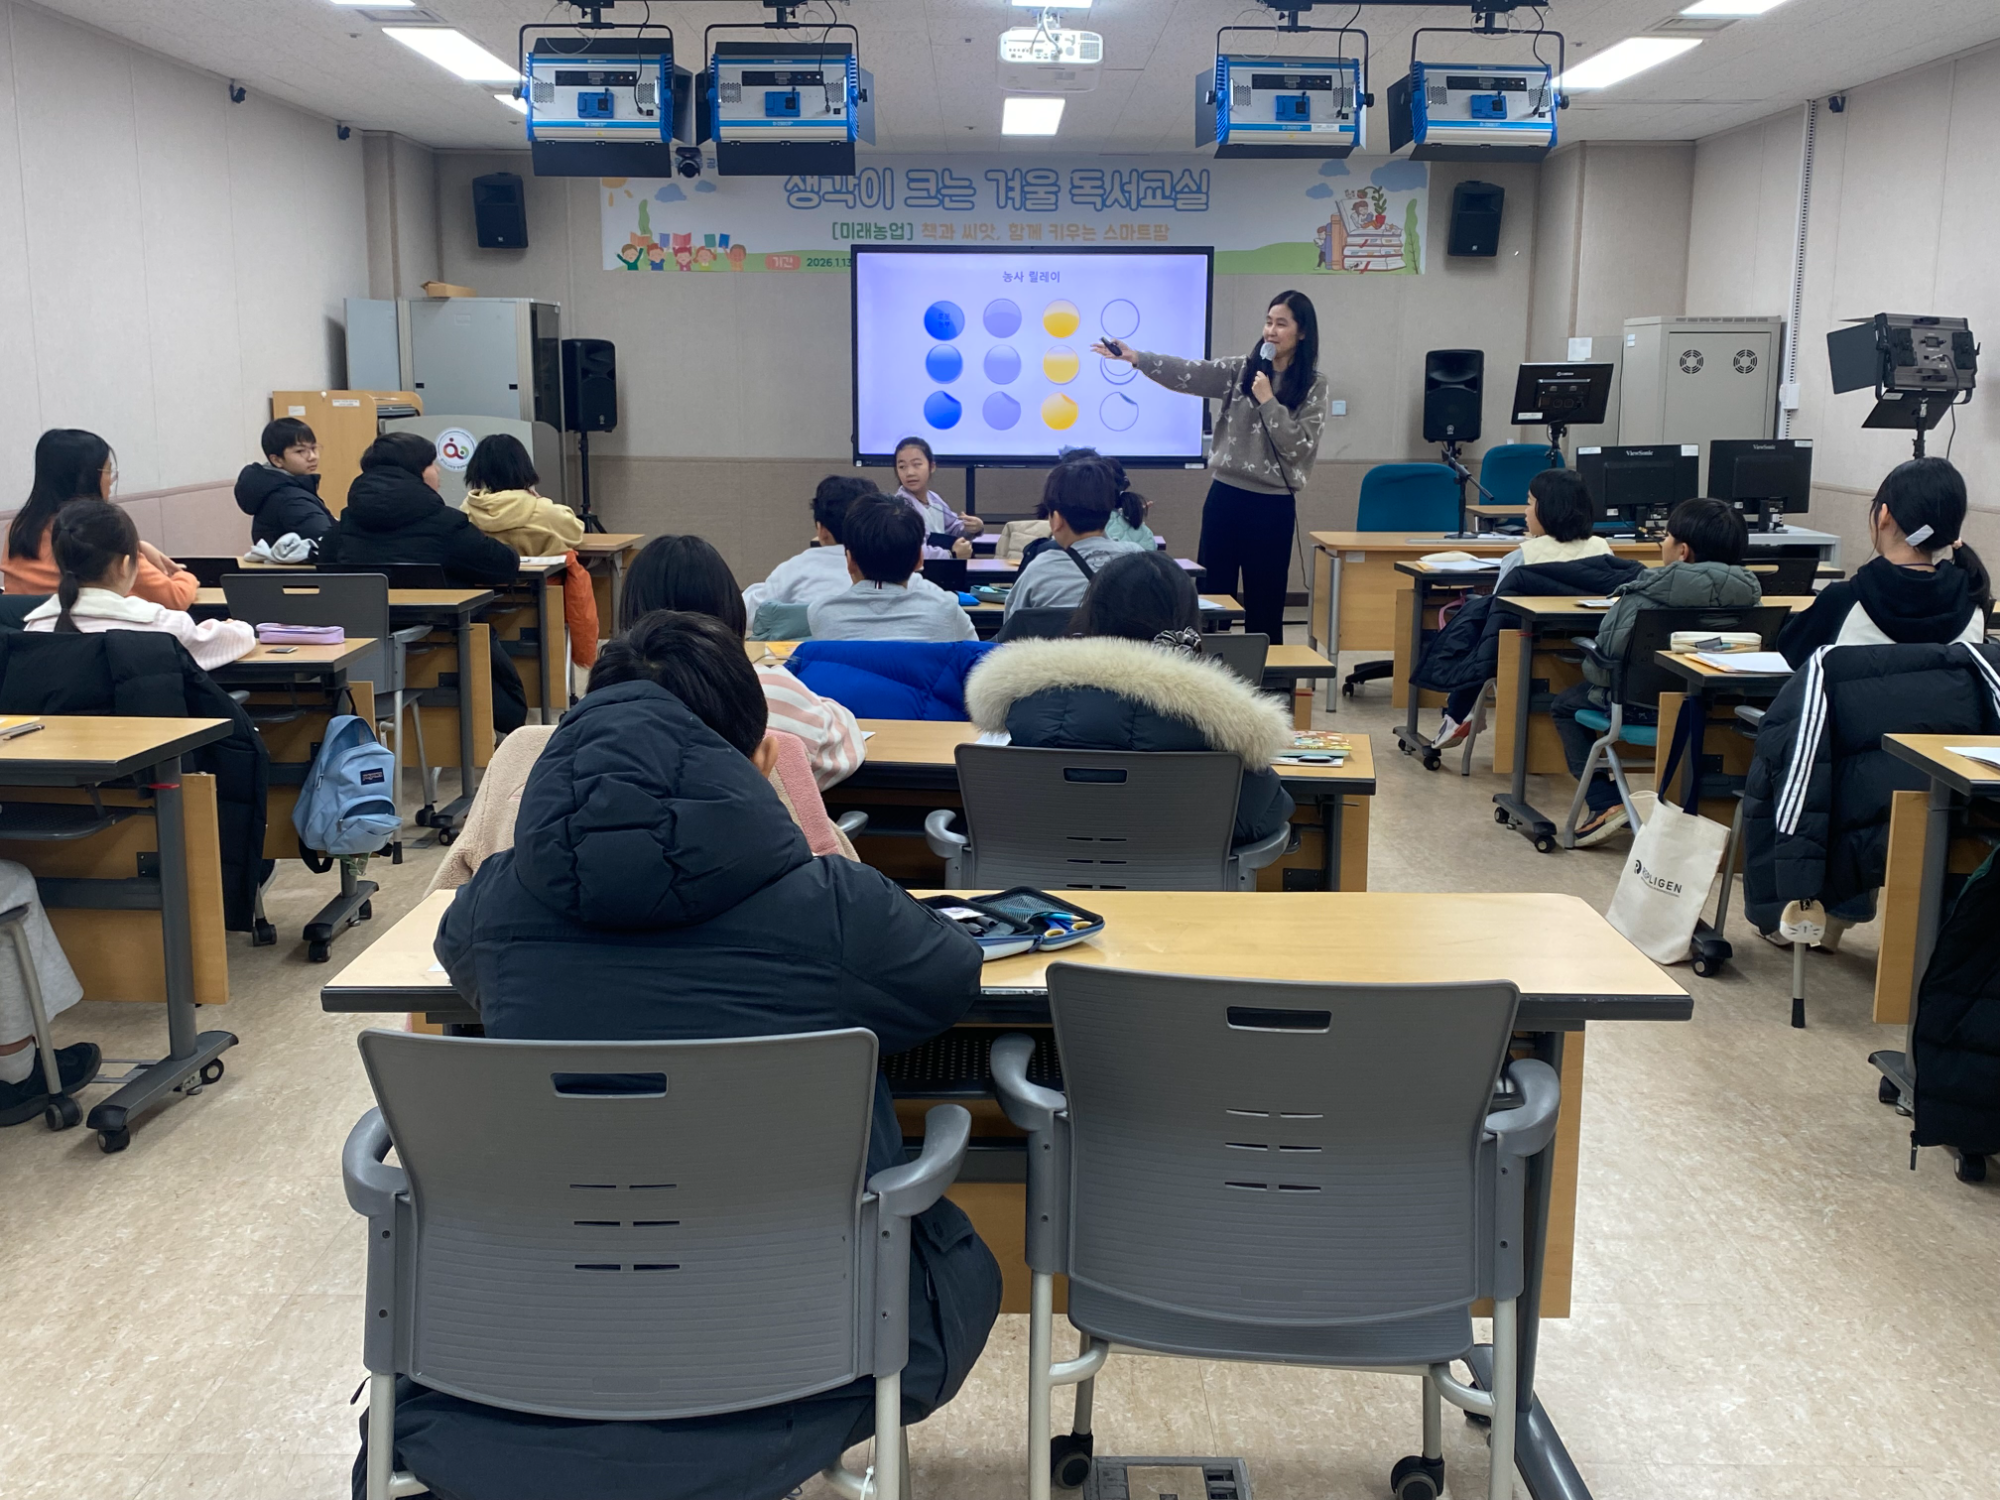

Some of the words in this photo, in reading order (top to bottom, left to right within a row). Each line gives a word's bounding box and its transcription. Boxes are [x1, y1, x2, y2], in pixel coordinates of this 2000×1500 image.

[784, 167, 894, 210] 생각이
[904, 168, 976, 210] 크는
[984, 168, 1061, 211] 겨울
[1069, 168, 1210, 212] 독서교실
[832, 222, 914, 241] [미래농업]
[921, 222, 956, 241] 책과
[1008, 222, 1042, 241] 함께
[1048, 223, 1097, 241] 키우는
[1103, 223, 1170, 242] 스마트팜
[773, 256, 794, 268] 기간
[1002, 271, 1024, 283] 농사
[1029, 271, 1060, 283] 릴레이
